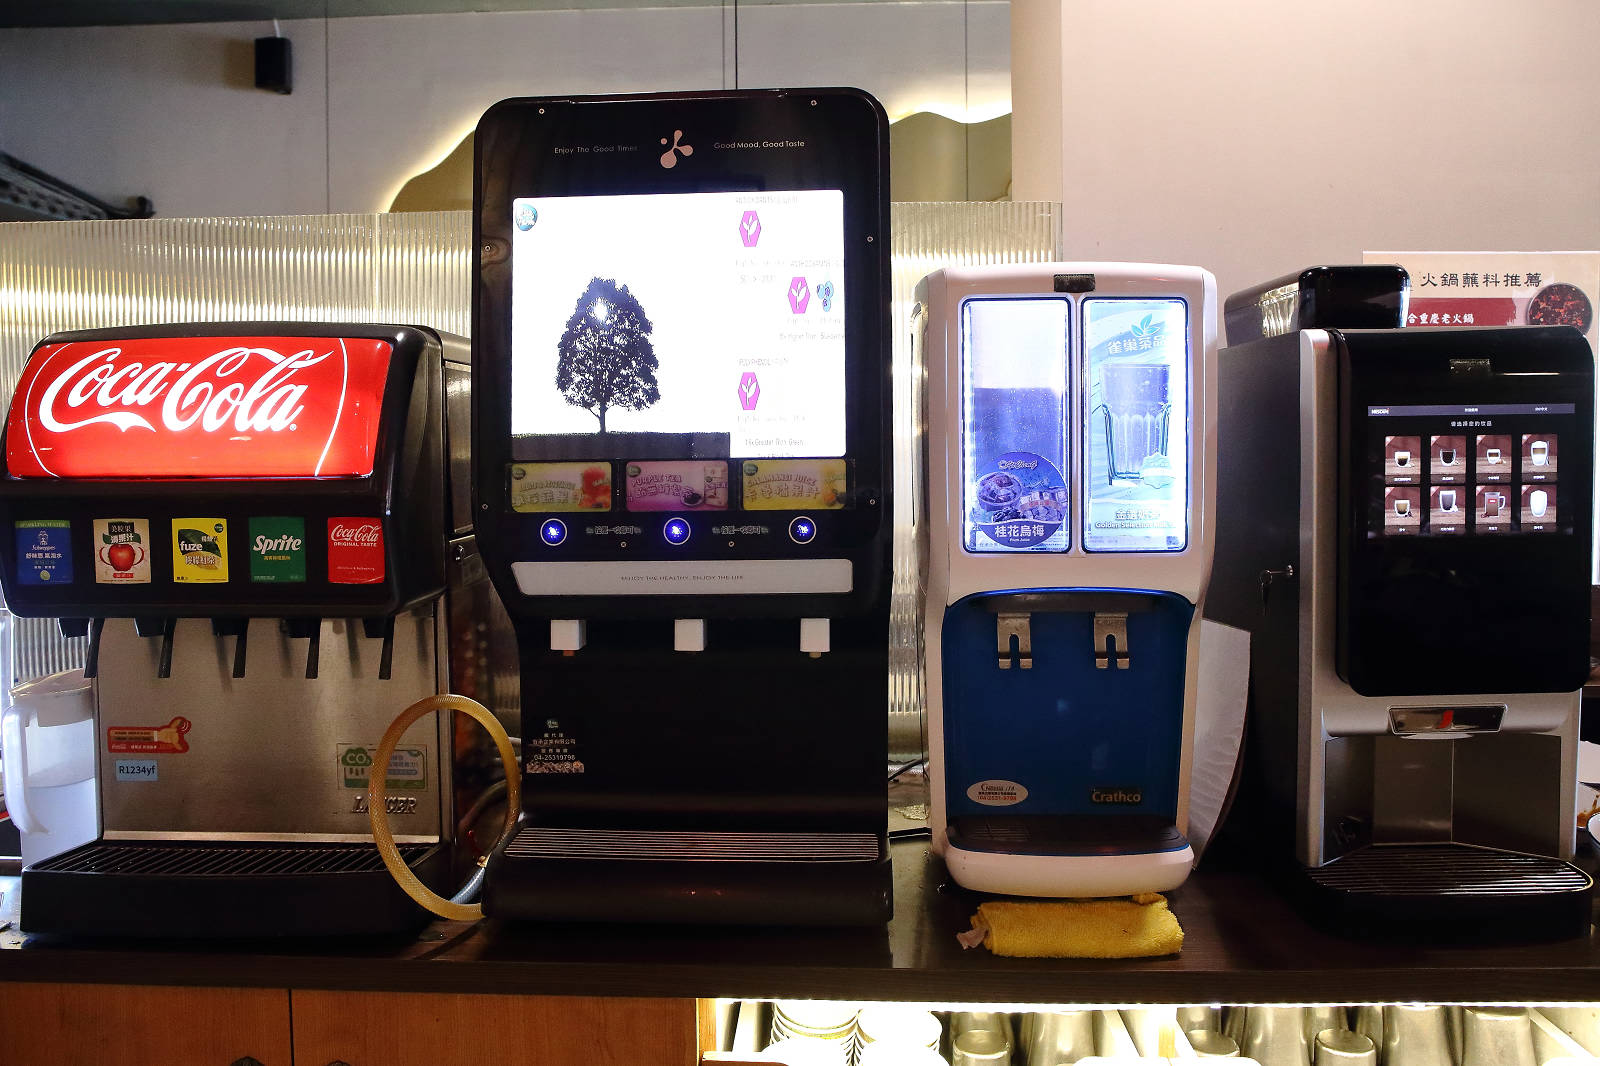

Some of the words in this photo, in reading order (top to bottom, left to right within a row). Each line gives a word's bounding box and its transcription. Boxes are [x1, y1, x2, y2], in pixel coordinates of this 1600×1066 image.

[554, 147, 574, 155] Enjoy
[593, 145, 614, 153] Good
[737, 141, 761, 150] Mood,
[785, 140, 805, 148] Taste
[39, 347, 334, 432] Coca-Cola
[331, 524, 381, 541] Coca-Cola
[180, 541, 203, 551] fuze
[253, 534, 302, 554] Sprite
[119, 765, 155, 776] R1234yf
[1091, 790, 1142, 803] Crathco
[351, 796, 417, 814] LCER
